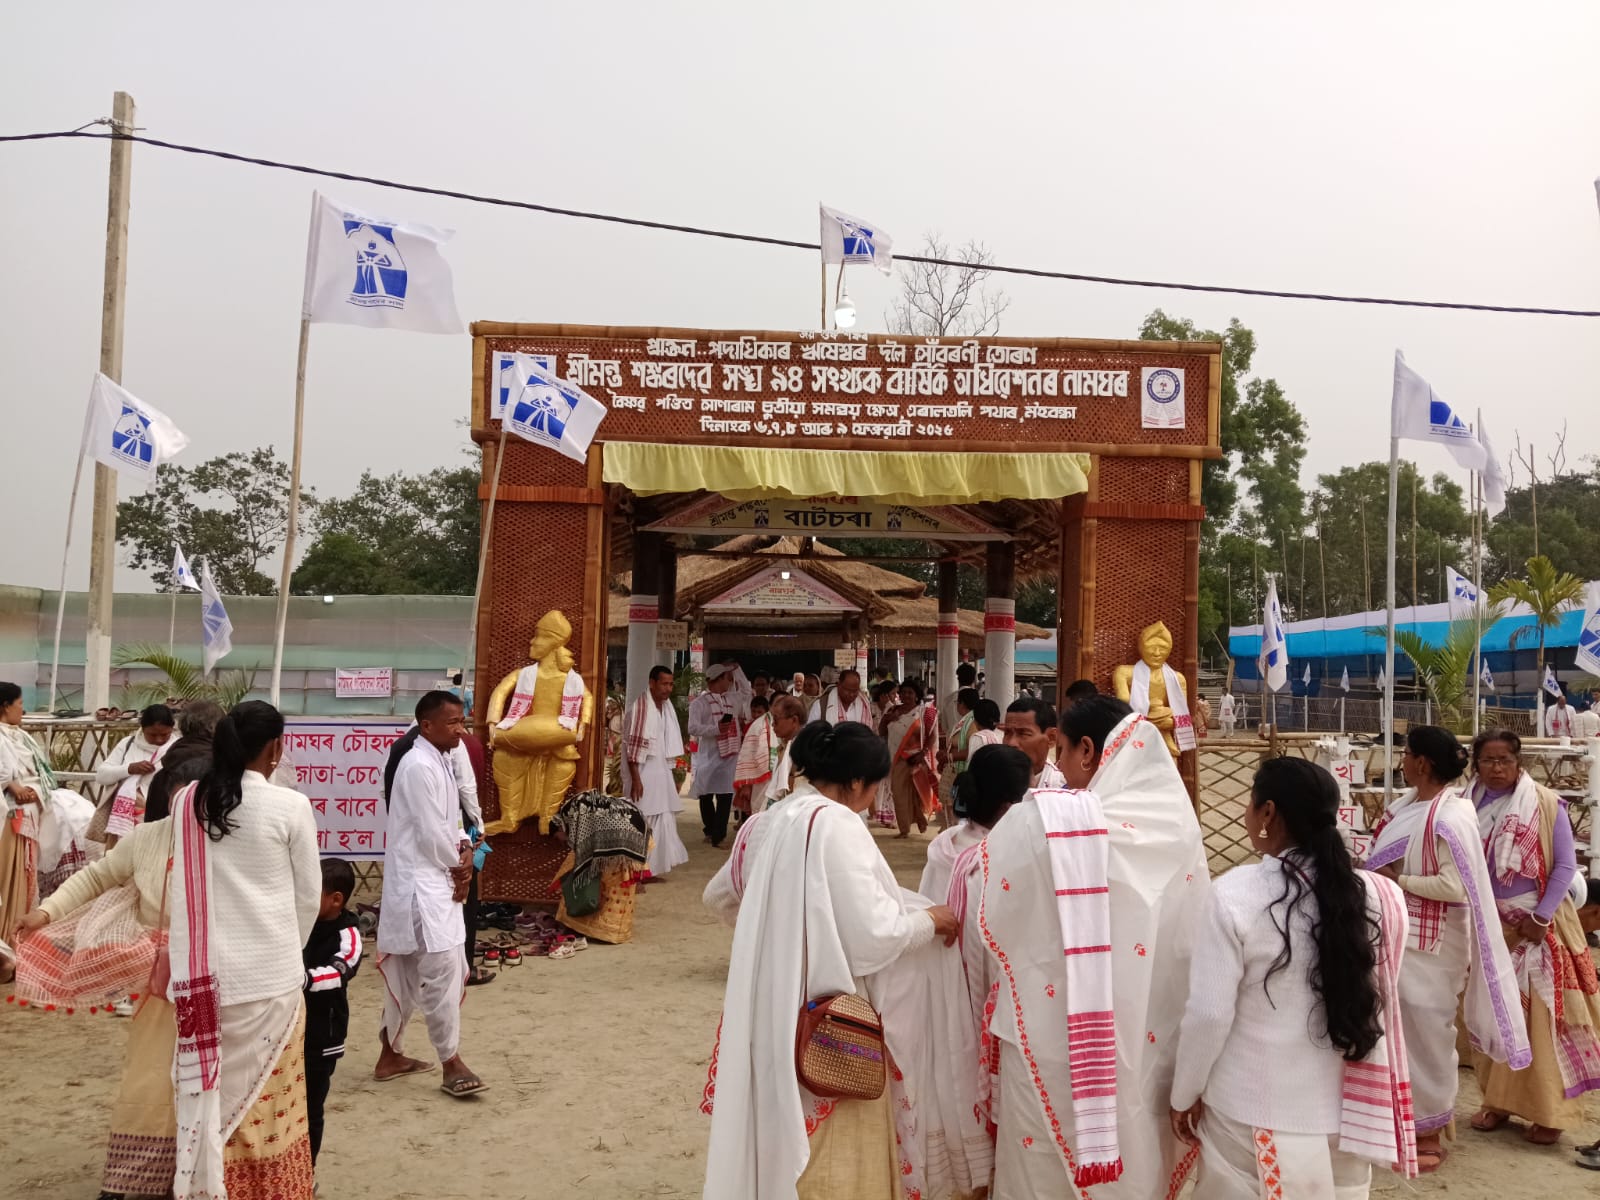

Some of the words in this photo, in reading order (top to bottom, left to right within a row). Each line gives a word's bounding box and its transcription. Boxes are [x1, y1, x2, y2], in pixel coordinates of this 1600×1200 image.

[646, 337, 698, 359] প্ৰাক্তন
[708, 335, 792, 361] পদাধিকাৰ
[800, 341, 868, 362] ঋষেশ্বৰ
[877, 339, 907, 363] দলৈ
[986, 345, 1039, 366] তোৰণ
[565, 352, 622, 389] শ্ৰীমন্ত
[629, 360, 713, 395] শঙ্কৰদেৱ
[770, 366, 803, 393] ৯৪
[811, 365, 882, 394] সংখ্যক
[886, 361, 949, 396] বাৰ্ষিক
[952, 362, 1060, 400] অধিৱেশনৰ
[1063, 369, 1131, 399] নামঘৰ
[655, 393, 694, 411] পণ্ডিত
[700, 397, 756, 413] সোণাৰাম
[699, 415, 751, 433] দিনাংক
[800, 421, 833, 436] আৰু
[784, 506, 872, 528] বাটচৰা
[1335, 762, 1356, 783] খ
[334, 797, 378, 817] বাবে
